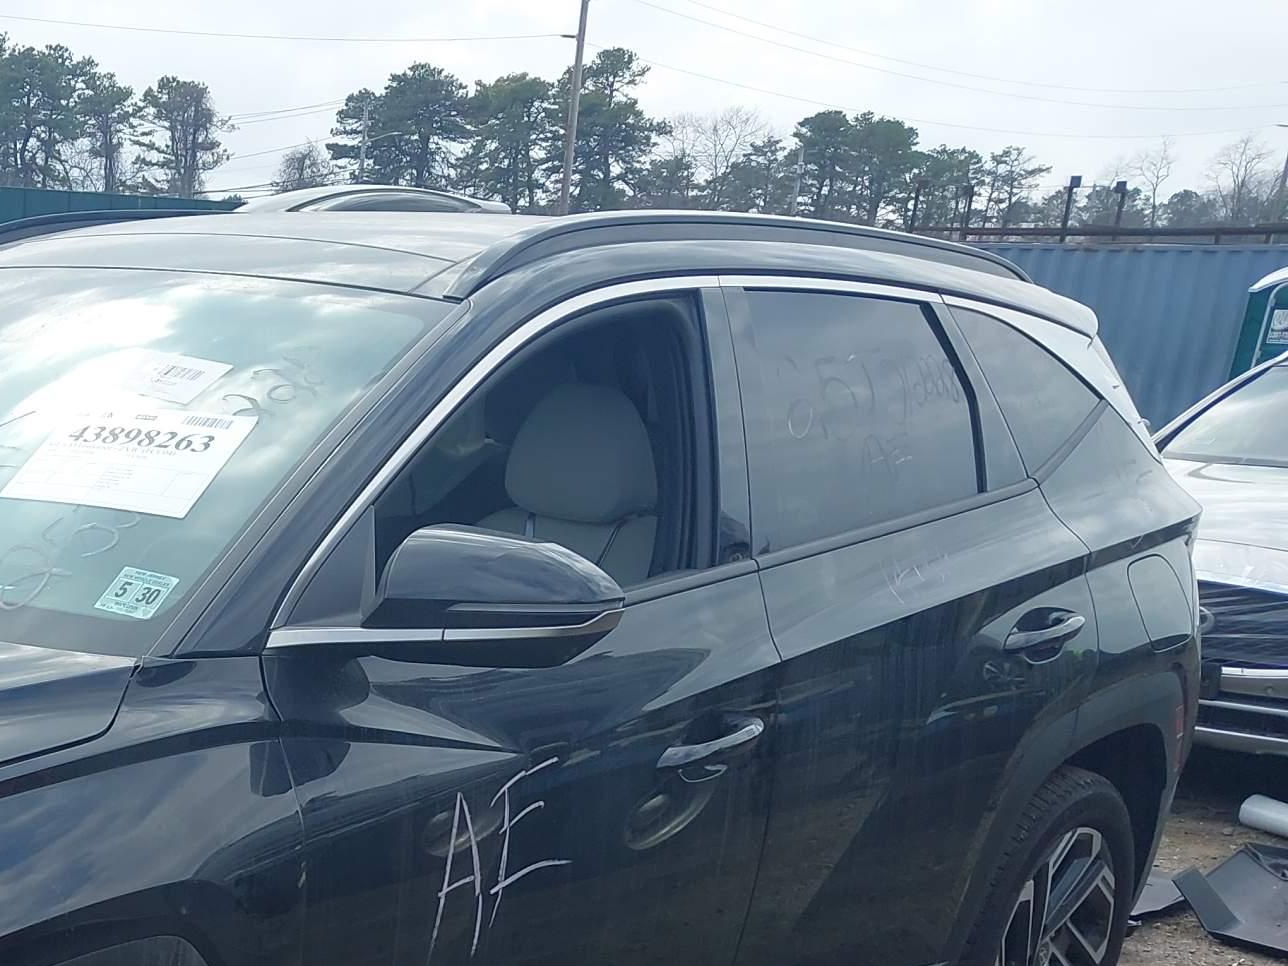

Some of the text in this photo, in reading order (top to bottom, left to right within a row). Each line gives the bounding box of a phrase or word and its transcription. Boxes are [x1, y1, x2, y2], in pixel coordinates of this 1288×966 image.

[67, 424, 215, 454] 43898263
[114, 581, 133, 597] 5
[135, 586, 161, 605] 30
